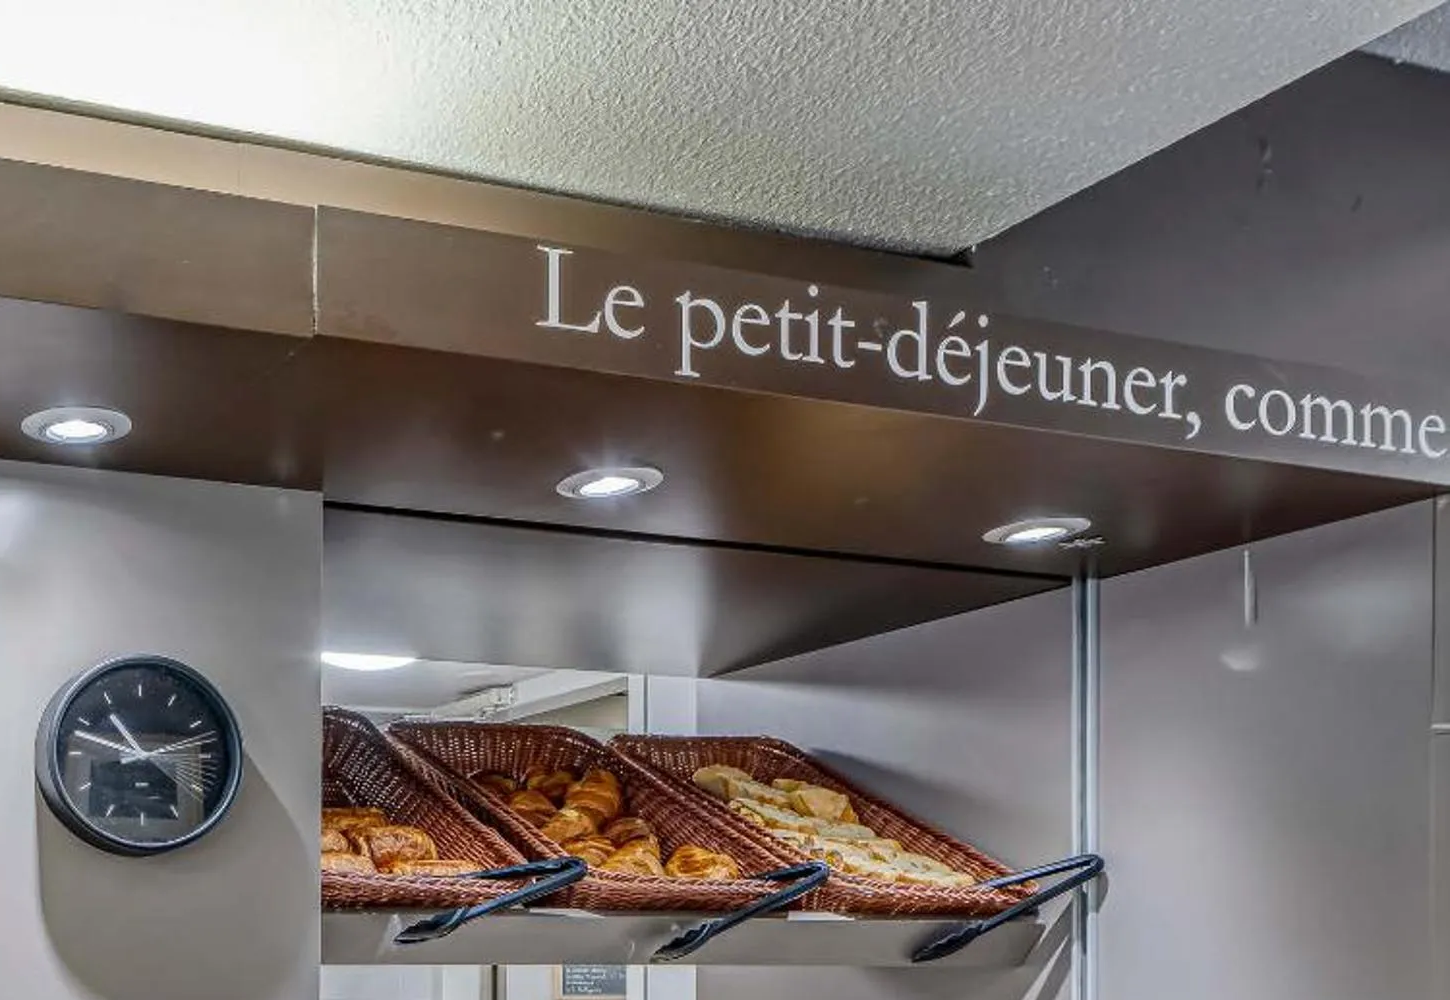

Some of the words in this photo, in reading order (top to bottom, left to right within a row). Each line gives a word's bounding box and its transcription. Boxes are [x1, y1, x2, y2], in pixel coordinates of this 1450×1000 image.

[535, 244, 646, 340] Le
[673, 284, 1202, 441] petit-déjeuner,
[1224, 381, 1449, 460] comme
